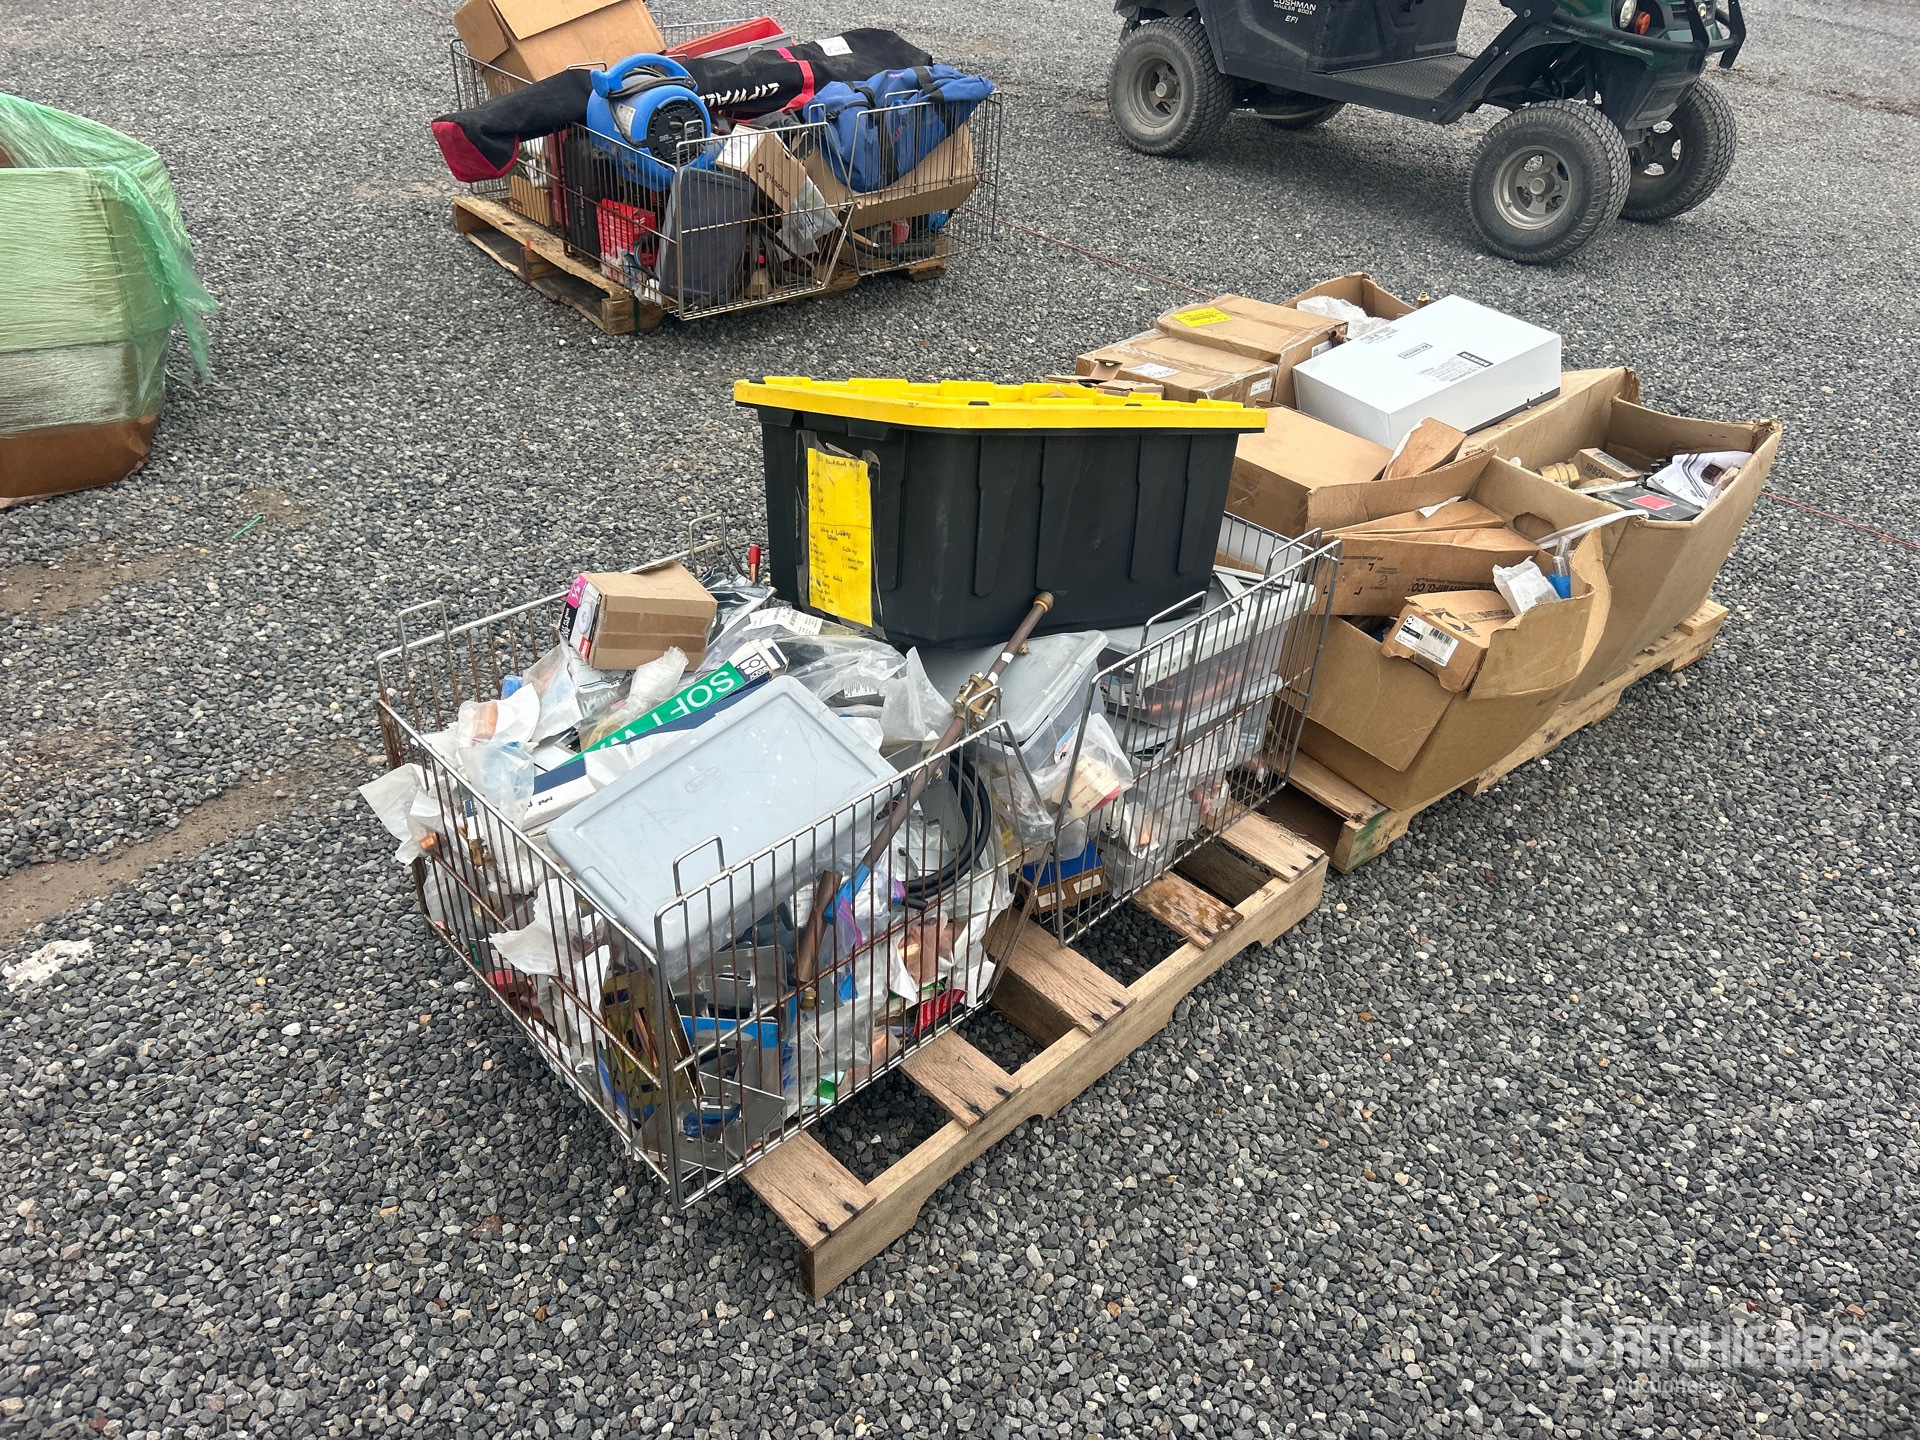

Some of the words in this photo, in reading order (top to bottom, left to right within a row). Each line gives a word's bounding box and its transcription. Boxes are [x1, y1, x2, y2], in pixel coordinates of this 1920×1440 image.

[1273, 4, 1295, 12] HAULER
[1284, 15, 1299, 24] EFI
[1585, 462, 1612, 479] 10929
[1410, 582, 1426, 593] CO.
